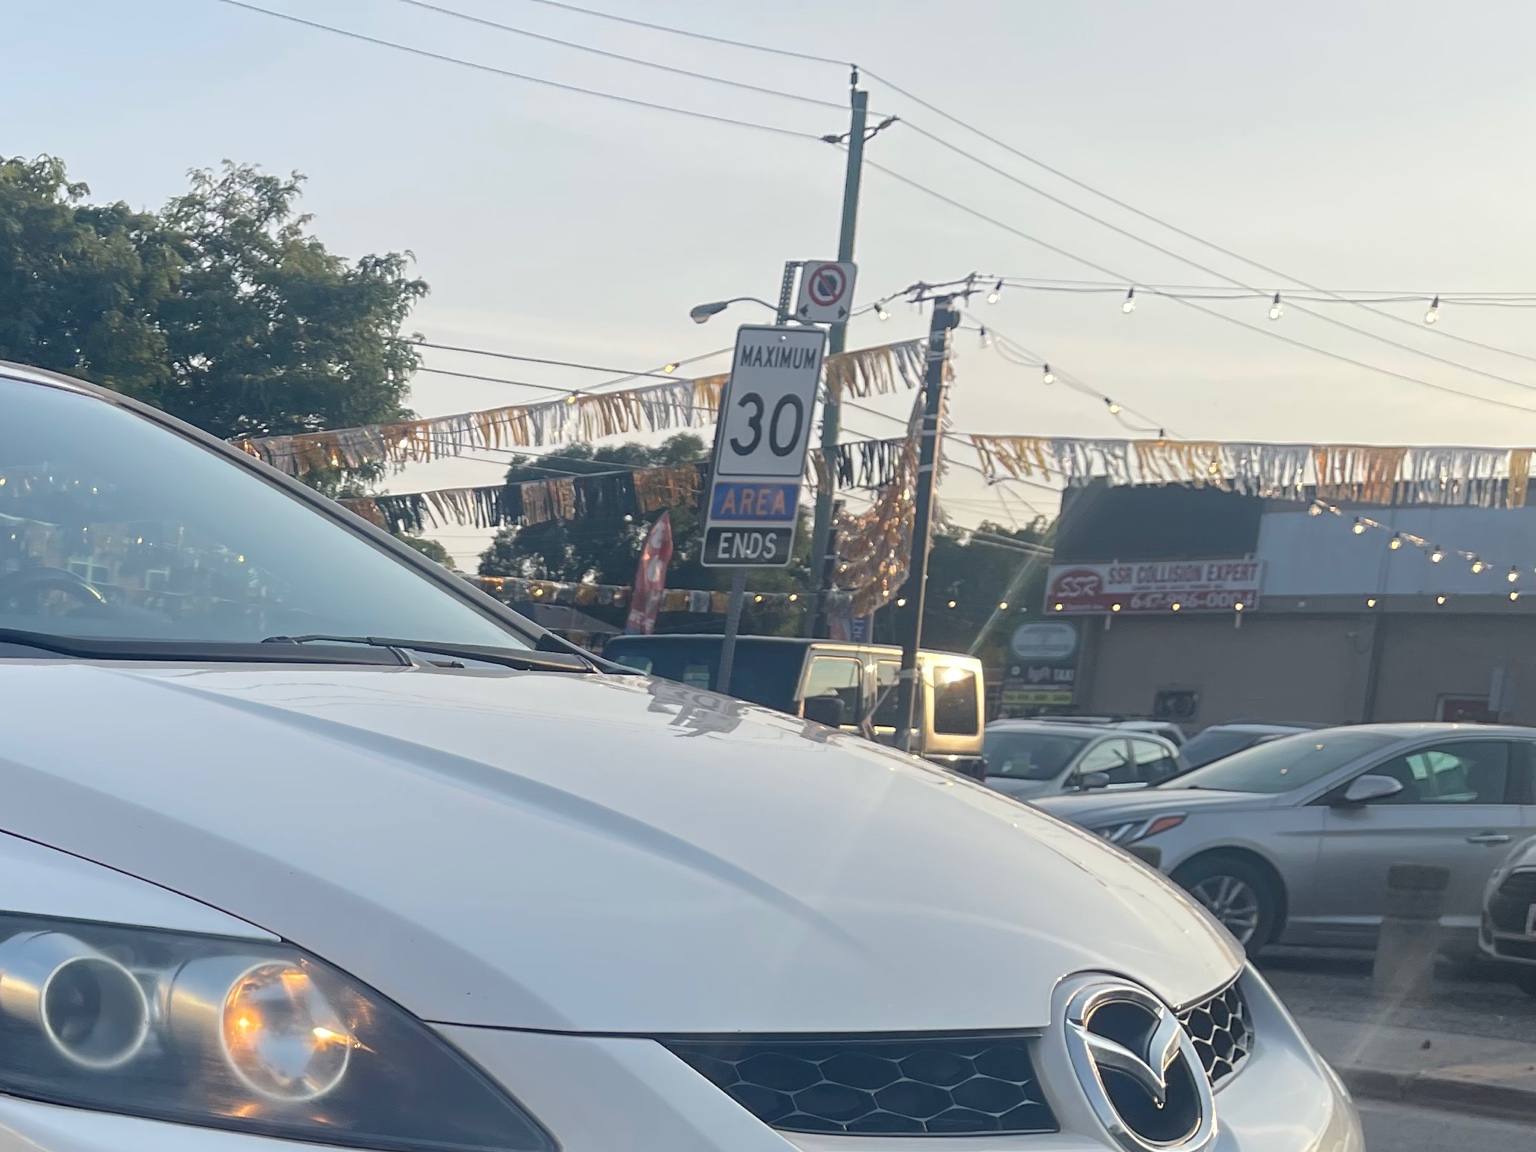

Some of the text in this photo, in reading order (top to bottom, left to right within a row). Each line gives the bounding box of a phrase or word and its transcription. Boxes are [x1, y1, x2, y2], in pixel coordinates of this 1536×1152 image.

[740, 344, 818, 370] MAXIMUM
[730, 391, 804, 457] 30
[720, 487, 786, 516] AREA
[717, 531, 777, 560] ENDS
[1206, 561, 1258, 582] EXPERT
